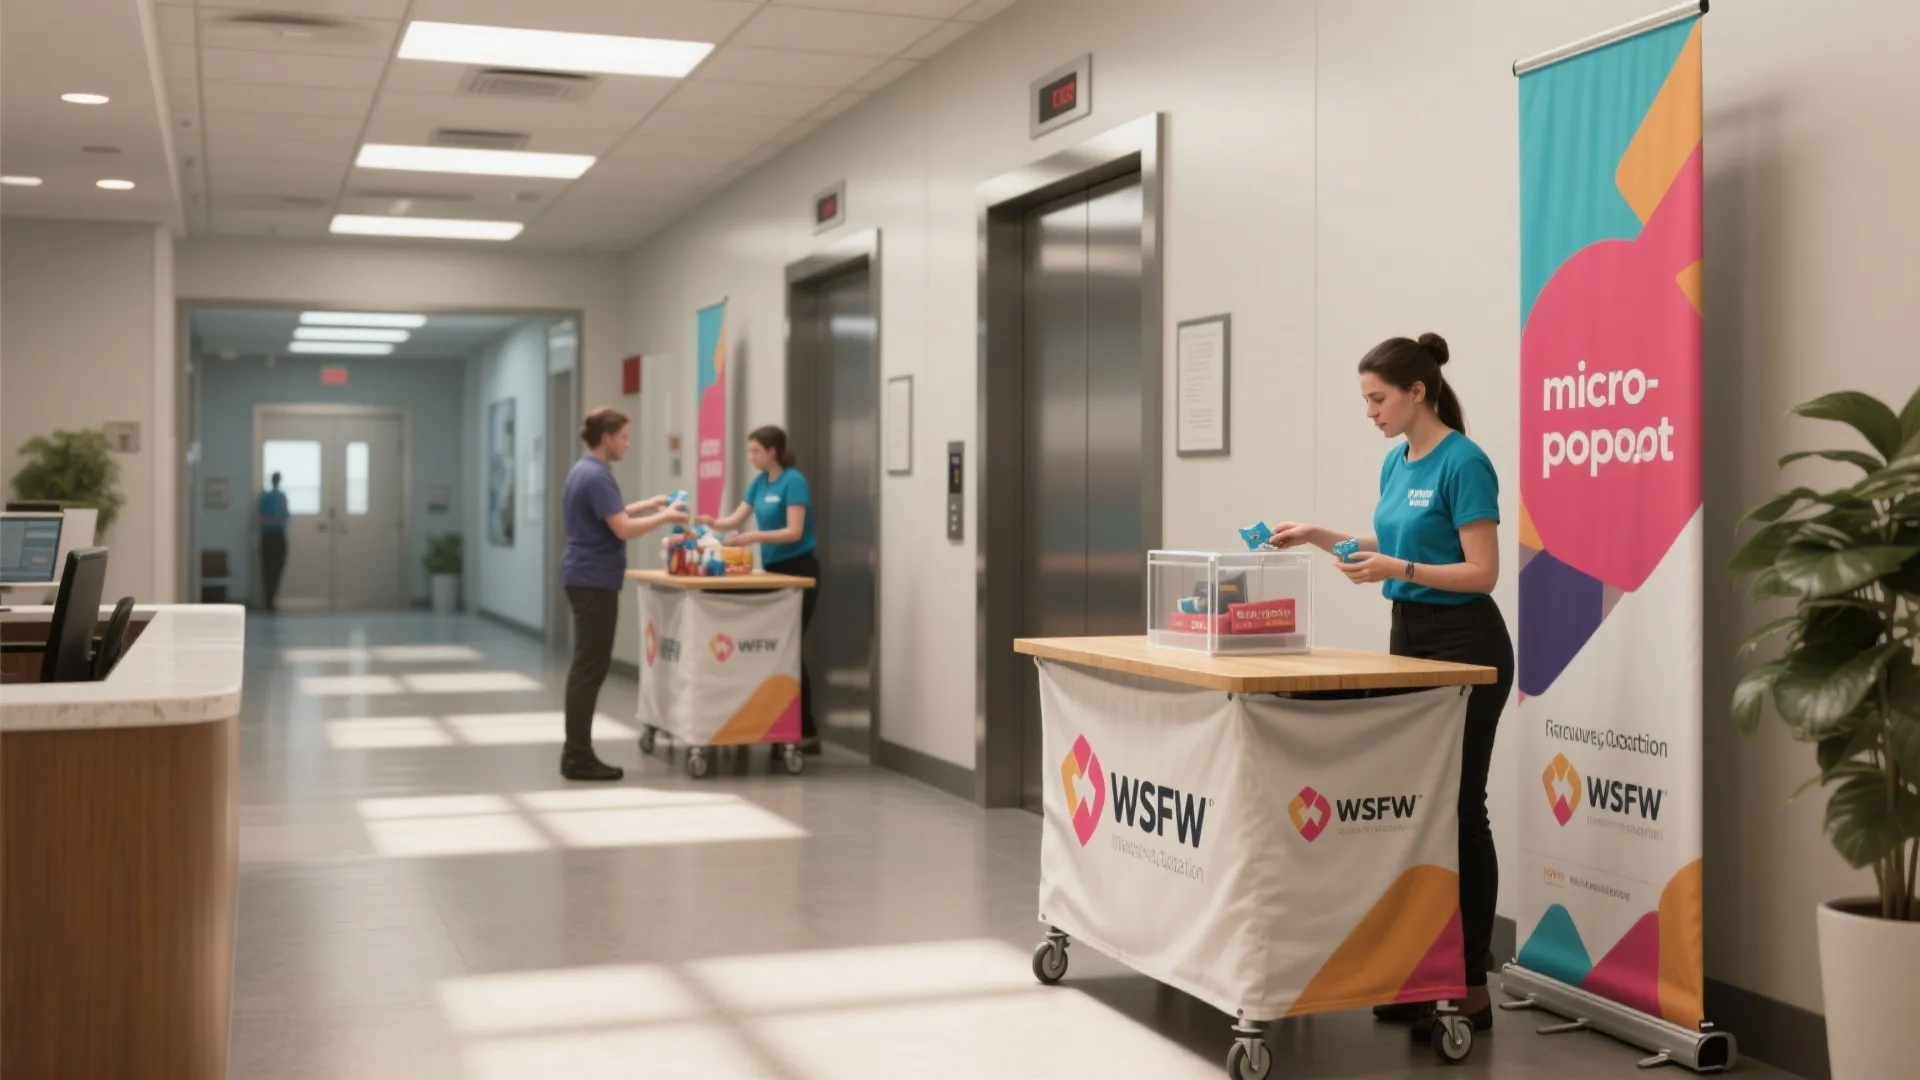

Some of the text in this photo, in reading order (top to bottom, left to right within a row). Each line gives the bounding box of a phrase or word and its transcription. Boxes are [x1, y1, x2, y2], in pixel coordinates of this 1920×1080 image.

[1543, 360, 1658, 411] micro-
[1111, 772, 1206, 849] WSFW
[1336, 794, 1416, 822] WSFW
[1587, 776, 1662, 821] WSFW
